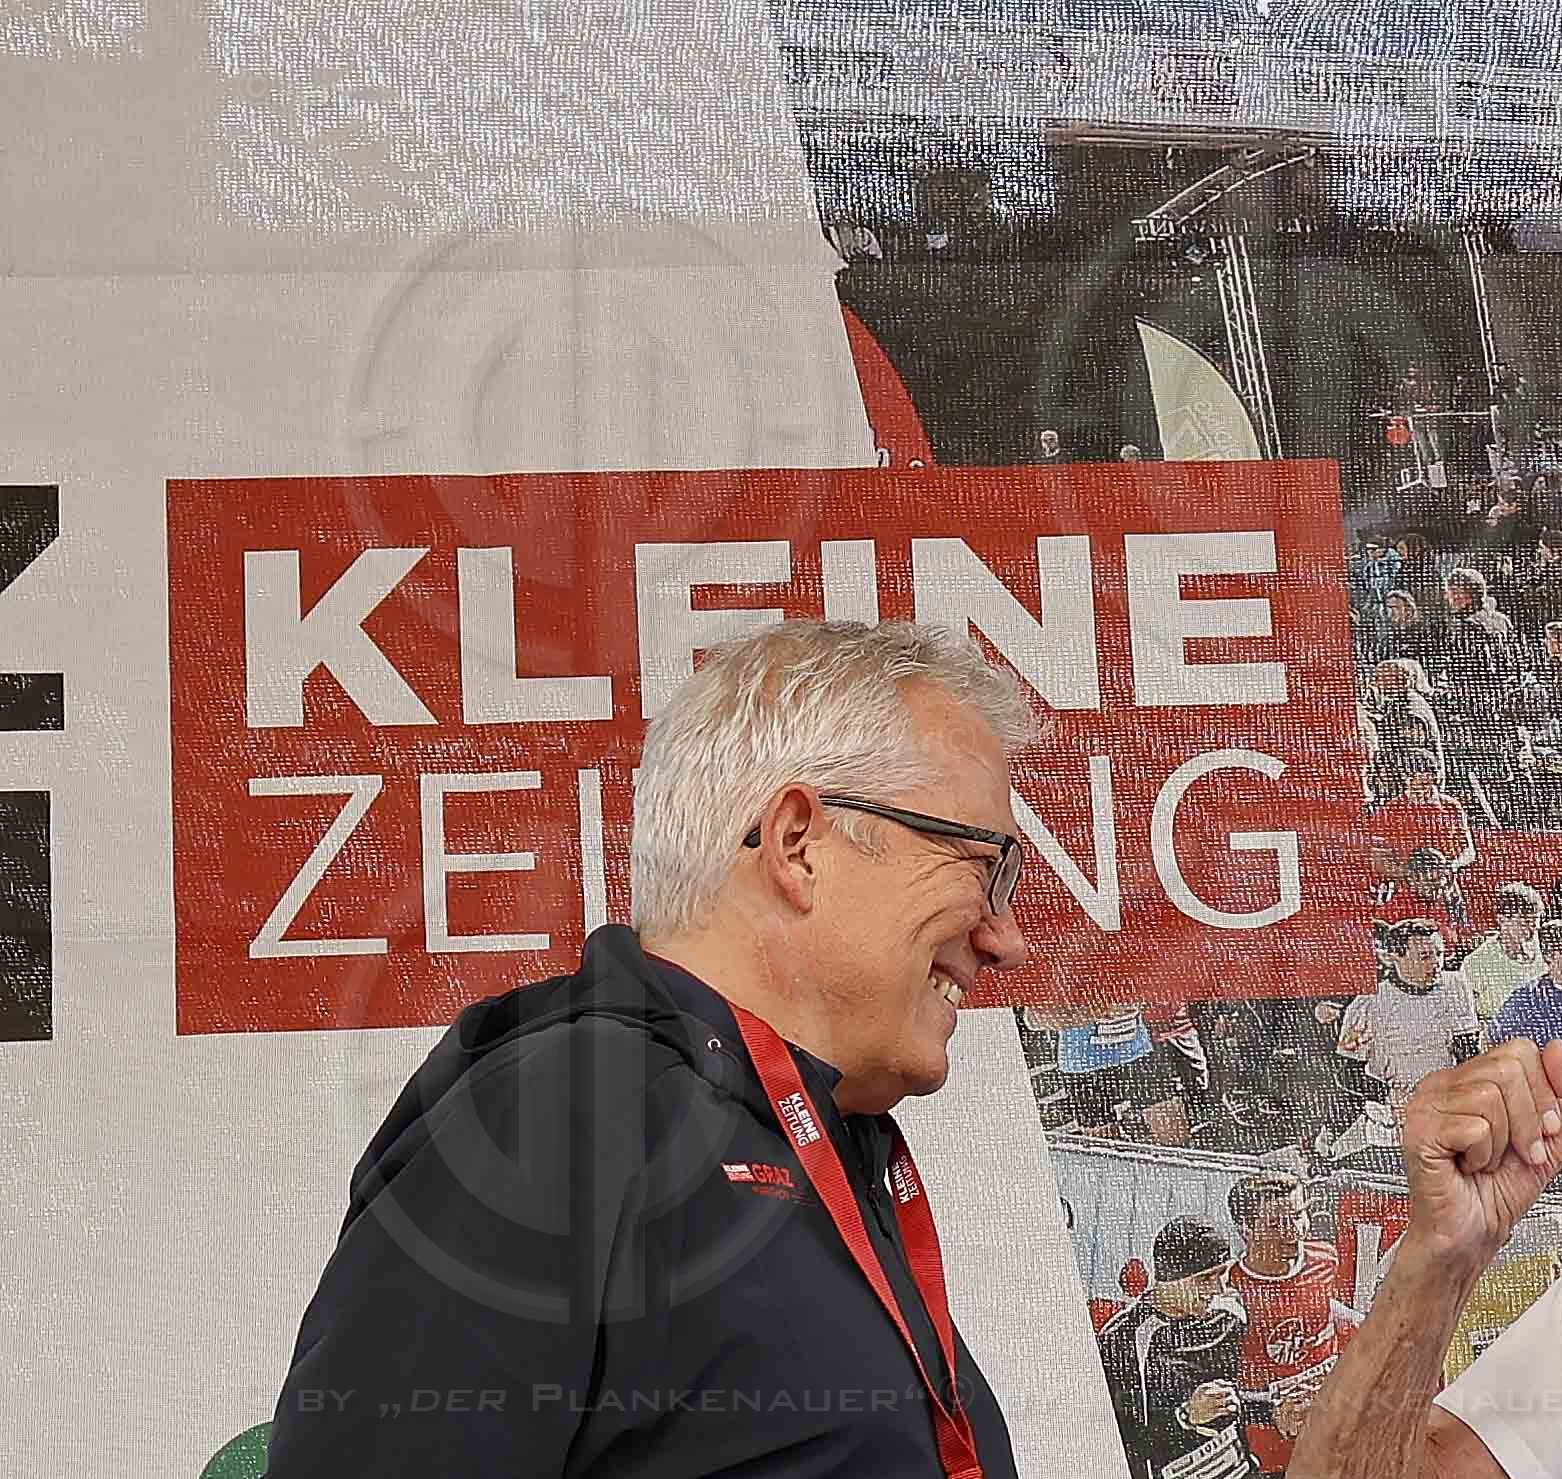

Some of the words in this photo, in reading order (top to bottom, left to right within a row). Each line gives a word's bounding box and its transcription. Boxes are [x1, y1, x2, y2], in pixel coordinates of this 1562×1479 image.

[248, 747, 1303, 958] ZEING
[778, 1098, 810, 1147] ZEITUNG
[789, 1092, 822, 1143] KLEINE
[891, 1162, 911, 1204] KLEINE
